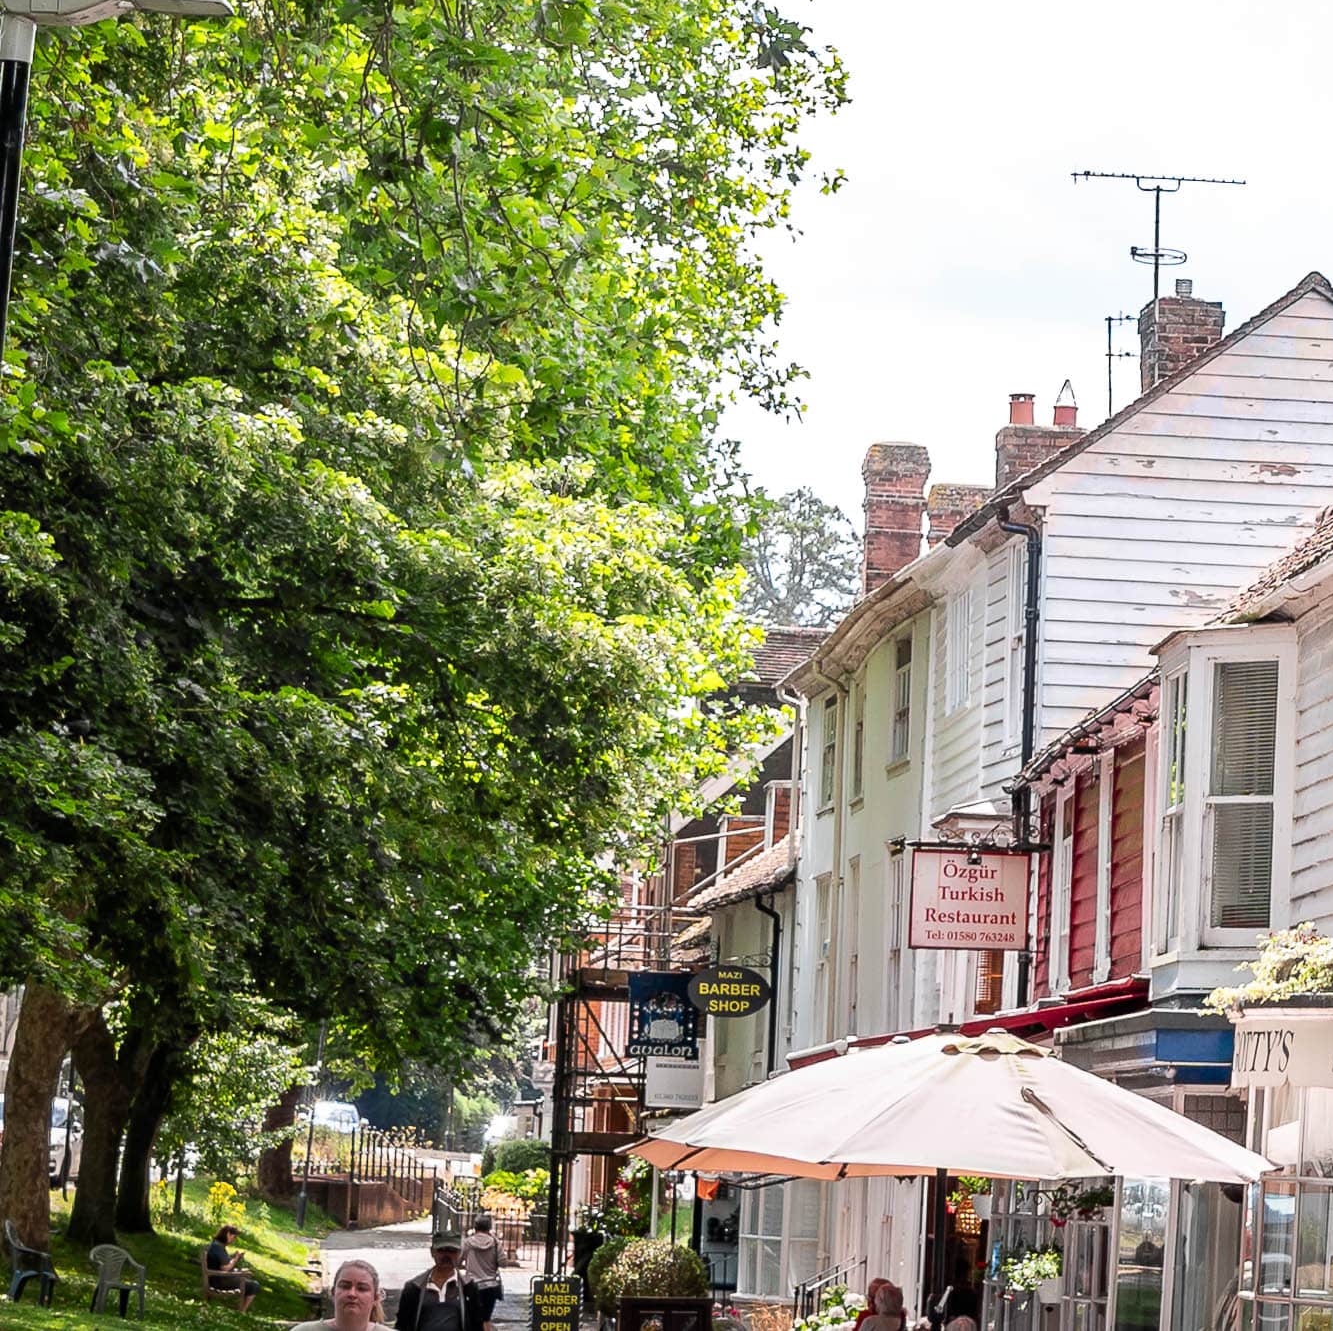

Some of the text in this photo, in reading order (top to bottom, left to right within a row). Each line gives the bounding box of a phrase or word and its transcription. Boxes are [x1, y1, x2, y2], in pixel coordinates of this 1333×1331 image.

[943, 860, 997, 883] Özgür
[939, 886, 1004, 902] Turkish
[925, 908, 1016, 925] Restaurant
[925, 930, 1015, 942] Tel: 01580 763248
[699, 982, 760, 996] BARBER
[709, 1000, 749, 1012] SHOP
[544, 1283, 570, 1293] MAZI
[535, 1294, 578, 1305] BARBER
[541, 1306, 570, 1316] SHOP
[540, 1321, 571, 1331] OPEN
